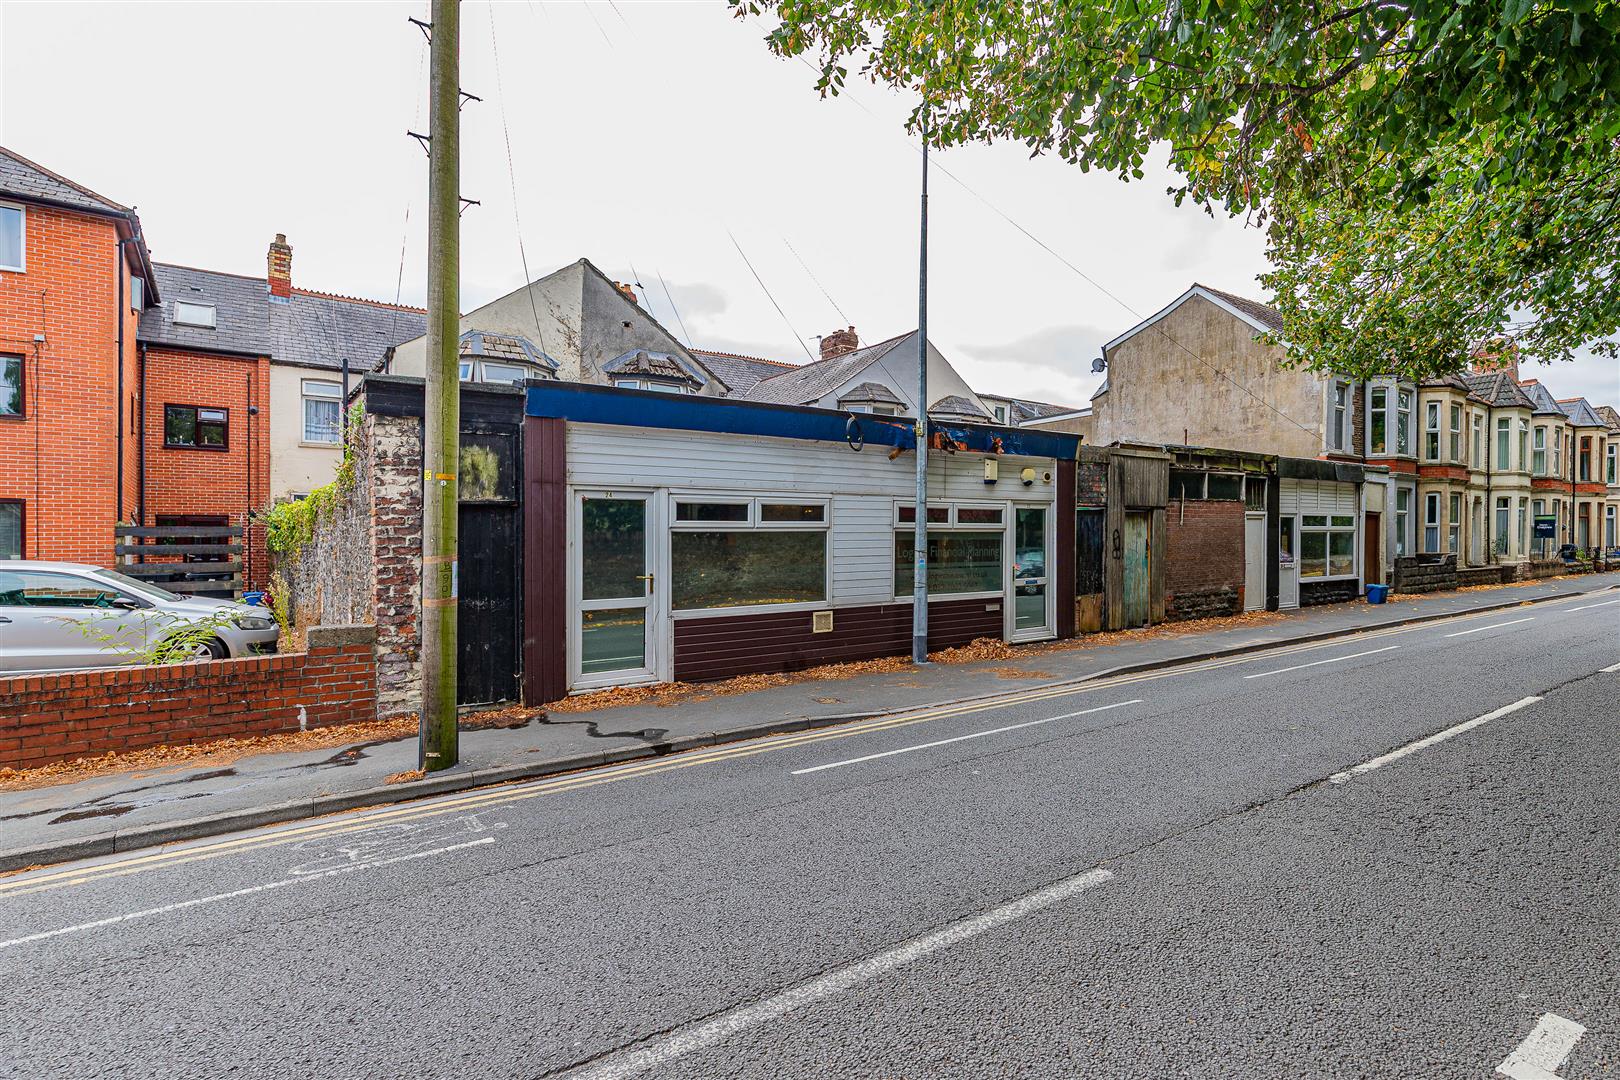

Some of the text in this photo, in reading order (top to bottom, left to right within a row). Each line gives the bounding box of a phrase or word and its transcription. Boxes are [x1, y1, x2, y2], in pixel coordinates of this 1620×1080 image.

[896, 545, 1000, 561] Log Financial Planning
